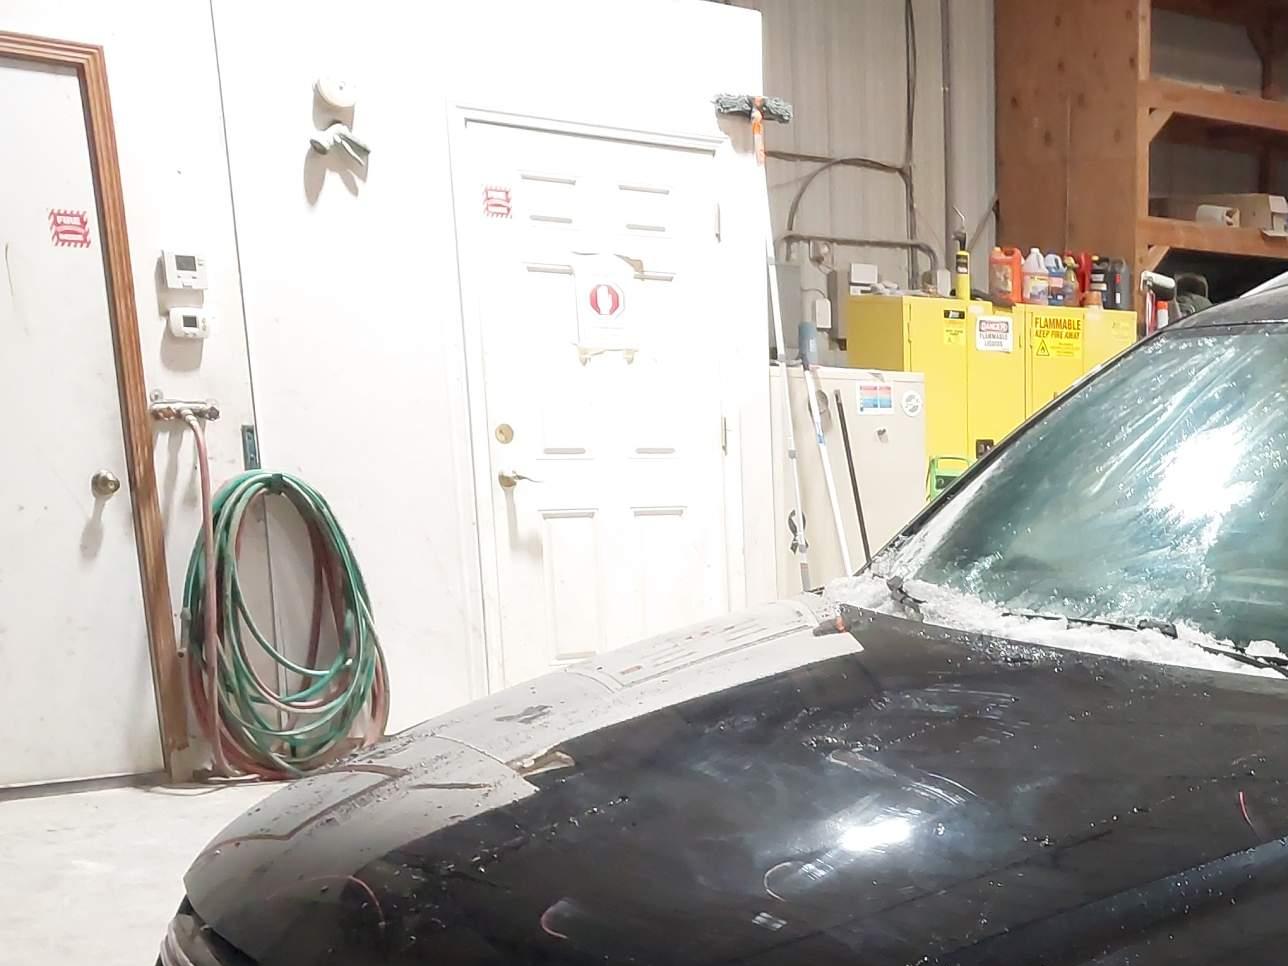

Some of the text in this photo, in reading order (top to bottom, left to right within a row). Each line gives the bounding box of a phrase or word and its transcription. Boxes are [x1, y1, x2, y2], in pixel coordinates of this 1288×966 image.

[1034, 316, 1081, 331] FLAMMABLE
[1034, 329, 1080, 340] KEEP FIRE AWAY
